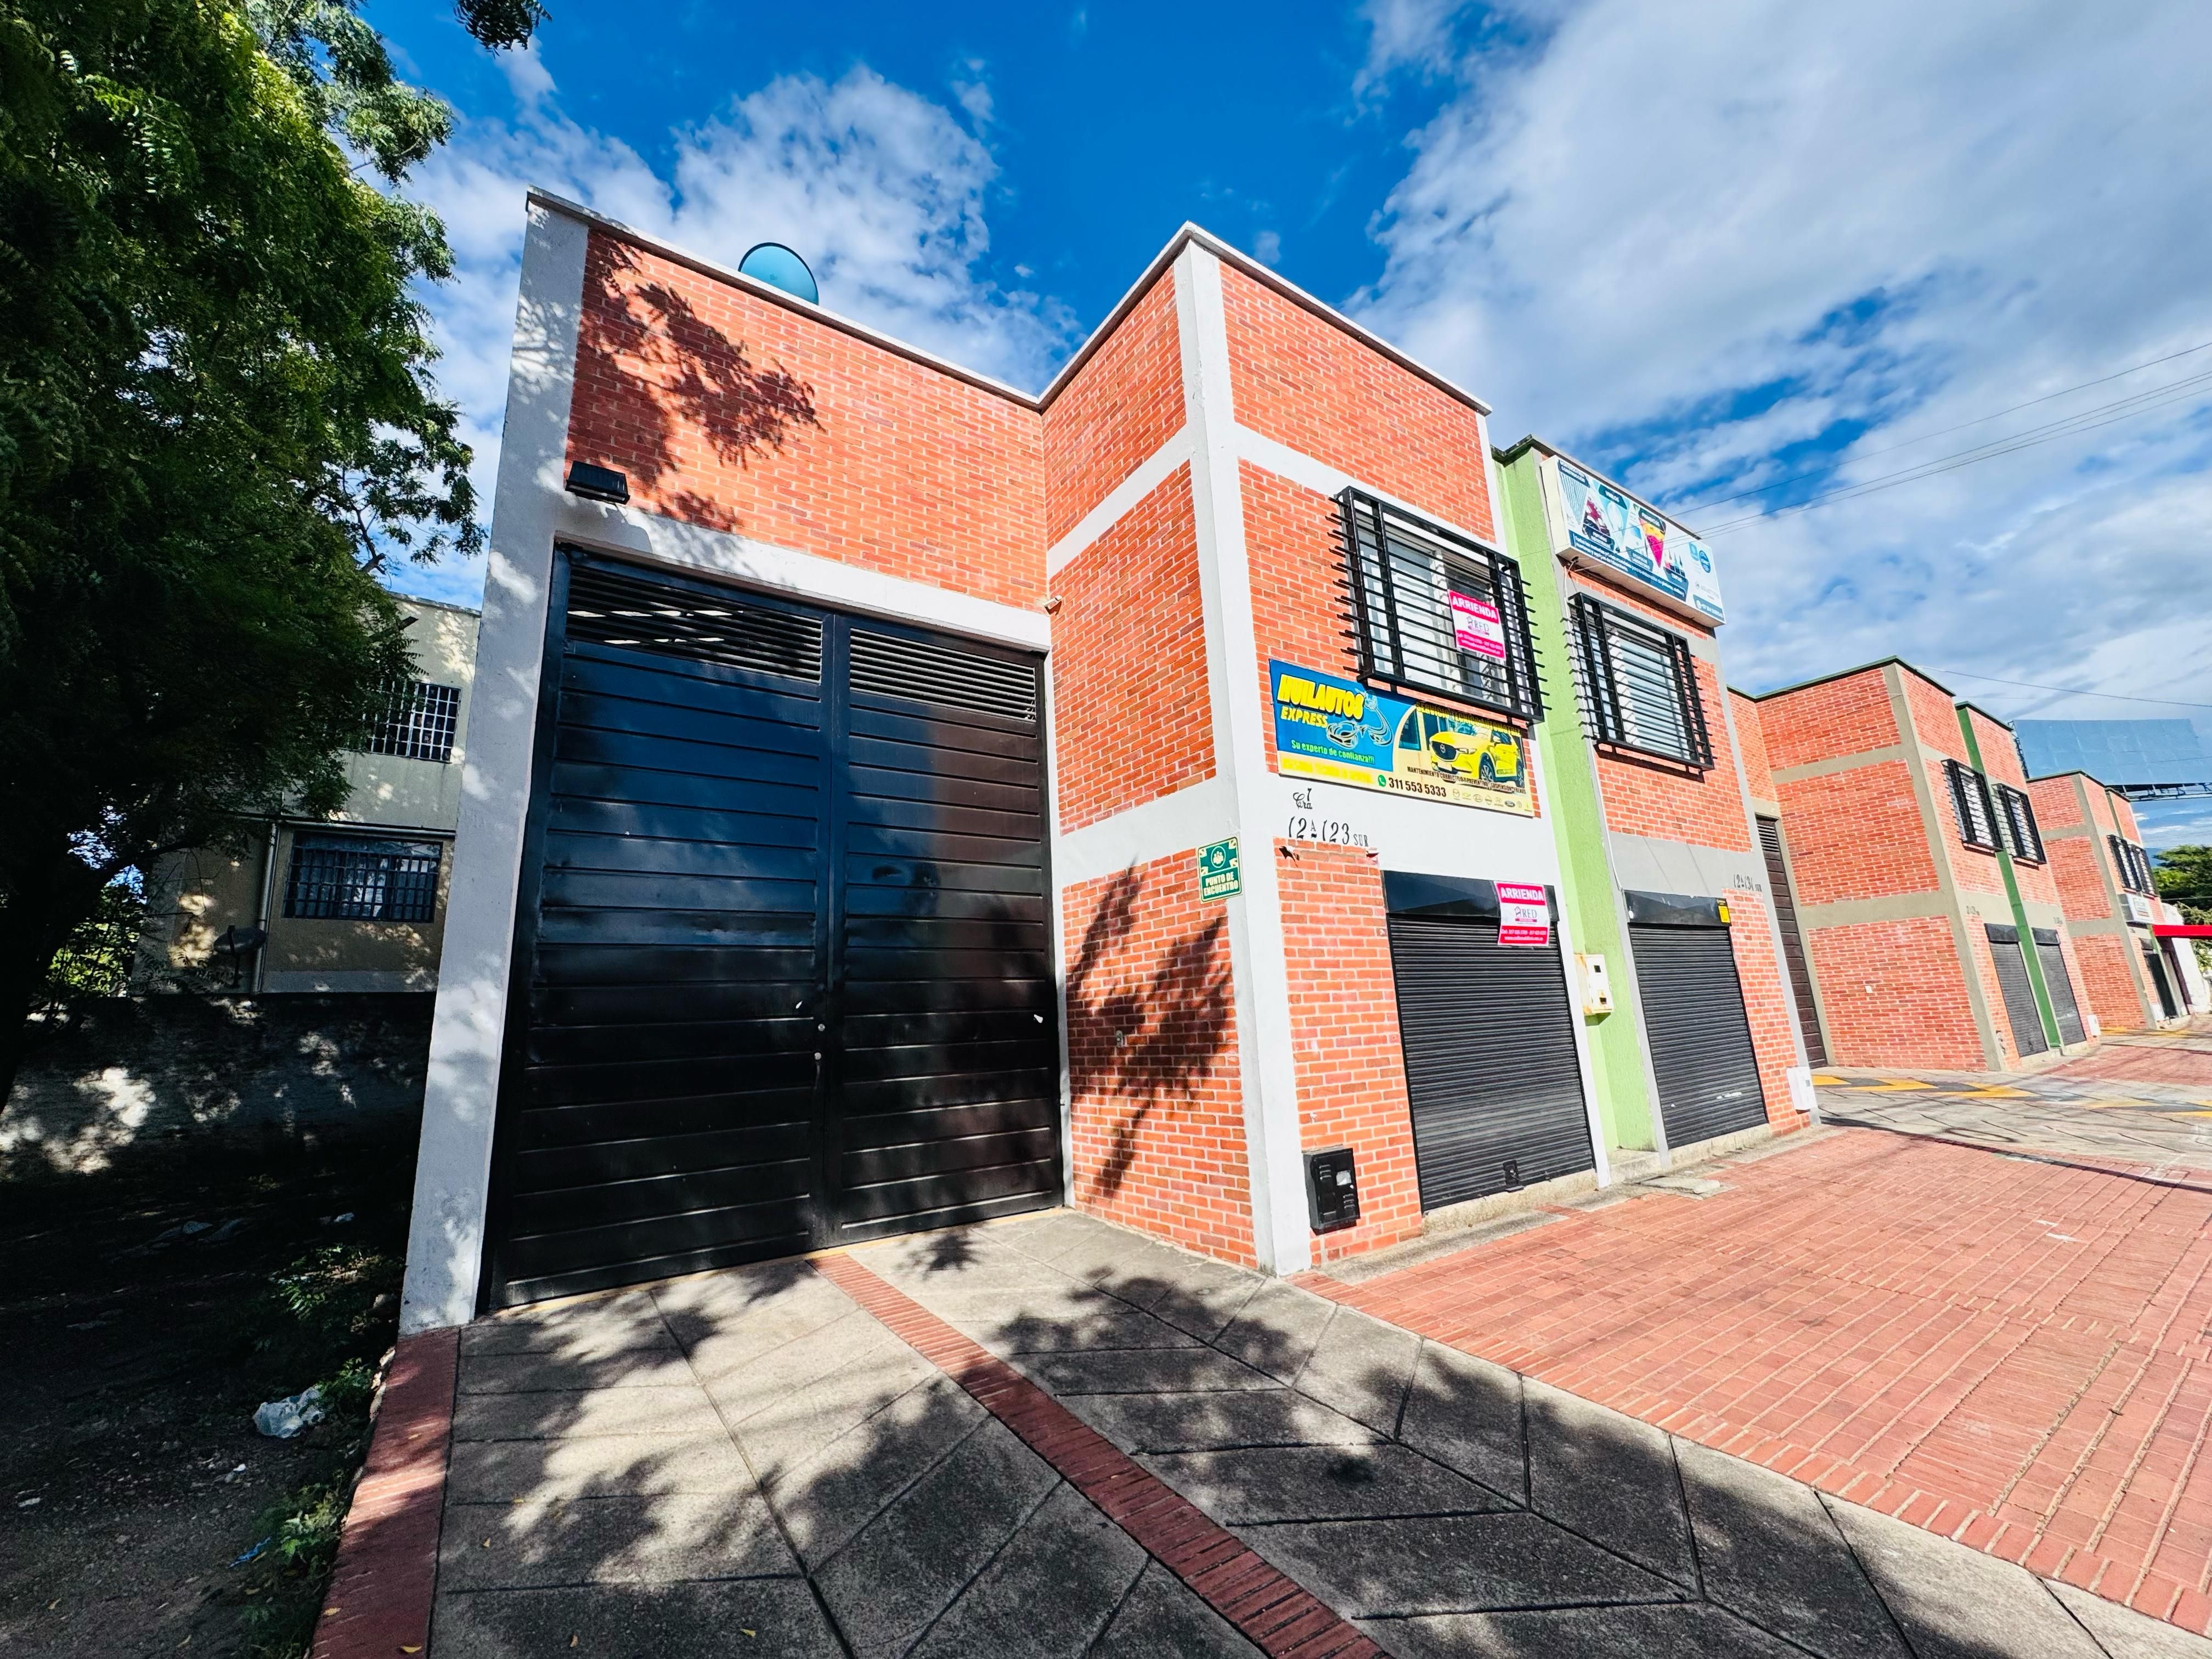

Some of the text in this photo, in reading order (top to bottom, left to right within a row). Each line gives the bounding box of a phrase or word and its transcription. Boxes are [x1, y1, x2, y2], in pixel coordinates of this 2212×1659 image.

[1452, 595, 1498, 620] ARRIENDA
[1277, 674, 1364, 720] HUILAUTOS
[1280, 706, 1328, 729] EXPRESS
[1291, 739, 1301, 751] Su
[1301, 742, 1328, 755] experto
[1328, 747, 1337, 757] de
[1388, 777, 1447, 797] 311 553 5333
[1353, 833, 1369, 847] SUR
[1205, 871, 1234, 887] PUNTO DE
[1203, 880, 1239, 896] ENCUENTRO
[1500, 887, 1544, 901] ARRIENDA
[1522, 909, 1537, 918] RED
